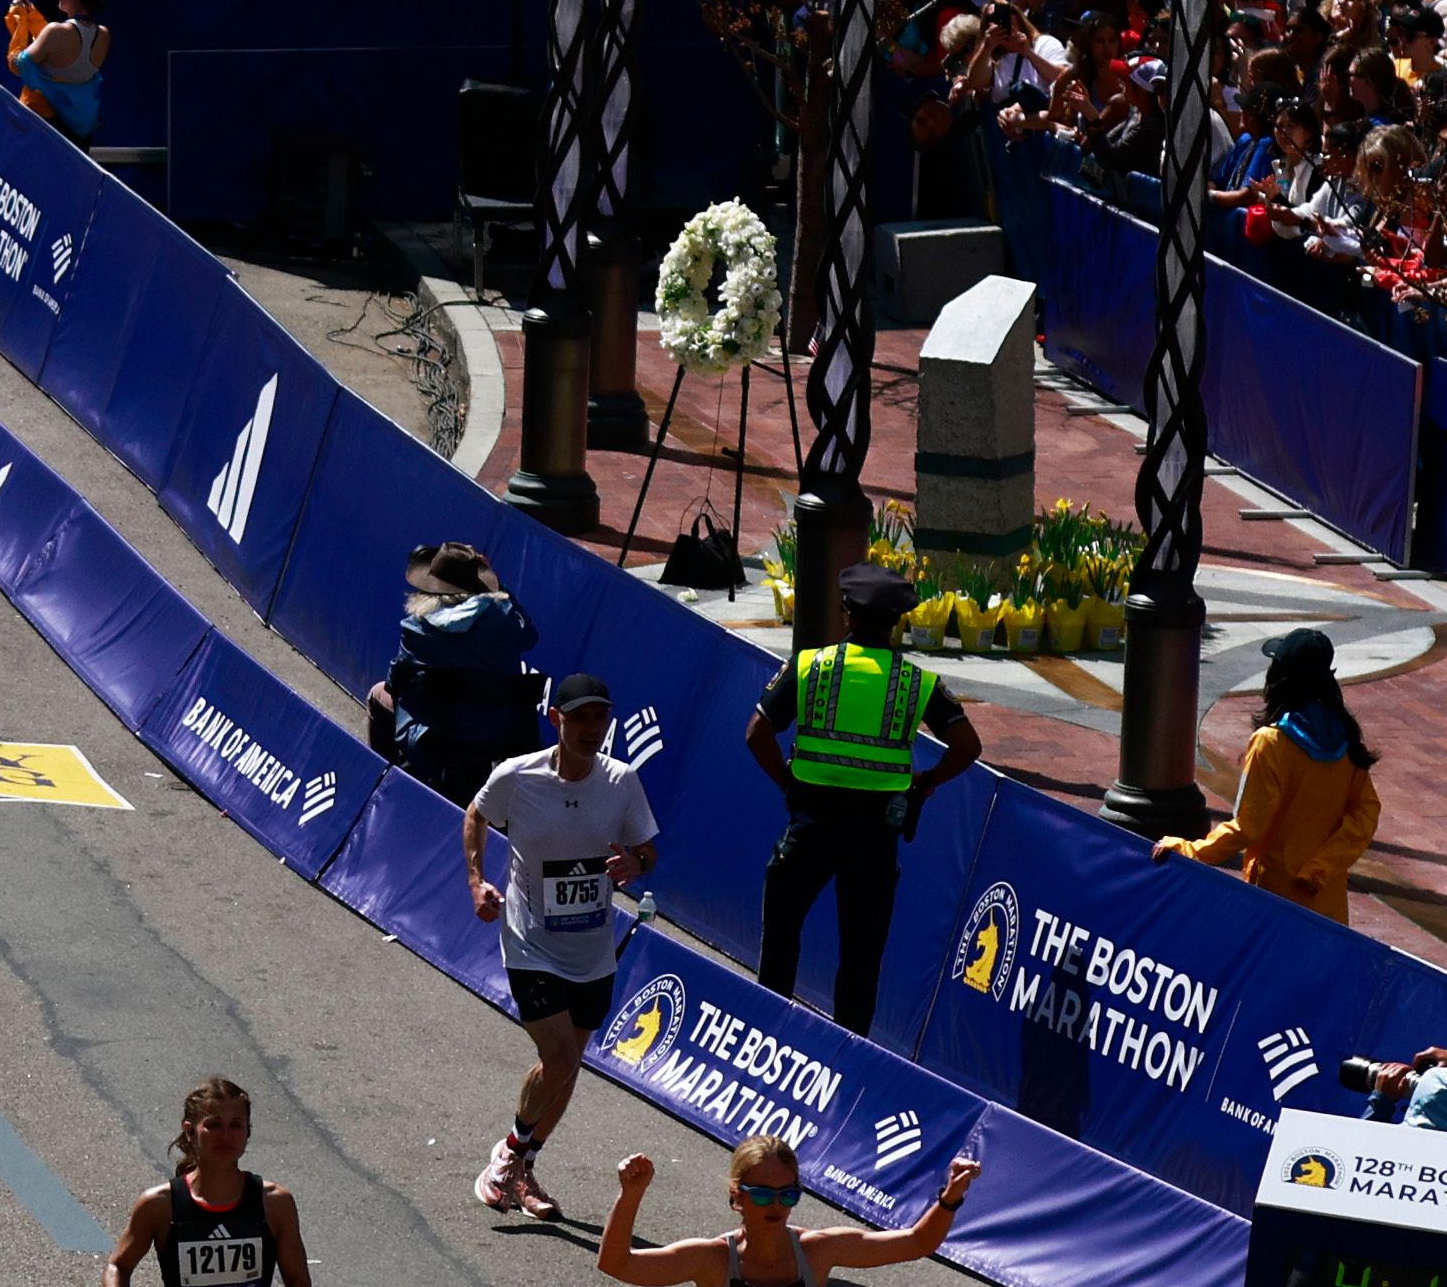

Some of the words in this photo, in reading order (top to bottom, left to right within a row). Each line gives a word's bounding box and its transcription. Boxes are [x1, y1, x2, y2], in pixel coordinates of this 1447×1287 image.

[180, 695, 227, 748] BANK
[221, 718, 249, 767] OF
[243, 734, 302, 810] AMERICA
[555, 878, 599, 906] 8755
[1034, 907, 1089, 977] THE
[1086, 936, 1217, 1035] BOSTON
[634, 979, 674, 1008] BOSTON
[650, 983, 685, 1065] MARATHON
[699, 1001, 746, 1058] THE
[740, 1024, 843, 1111] BOSTON
[1219, 1096, 1250, 1125] BANK
[1248, 1110, 1265, 1129] OF
[1353, 1154, 1415, 1179] 128TH
[185, 1243, 257, 1276] 12179
